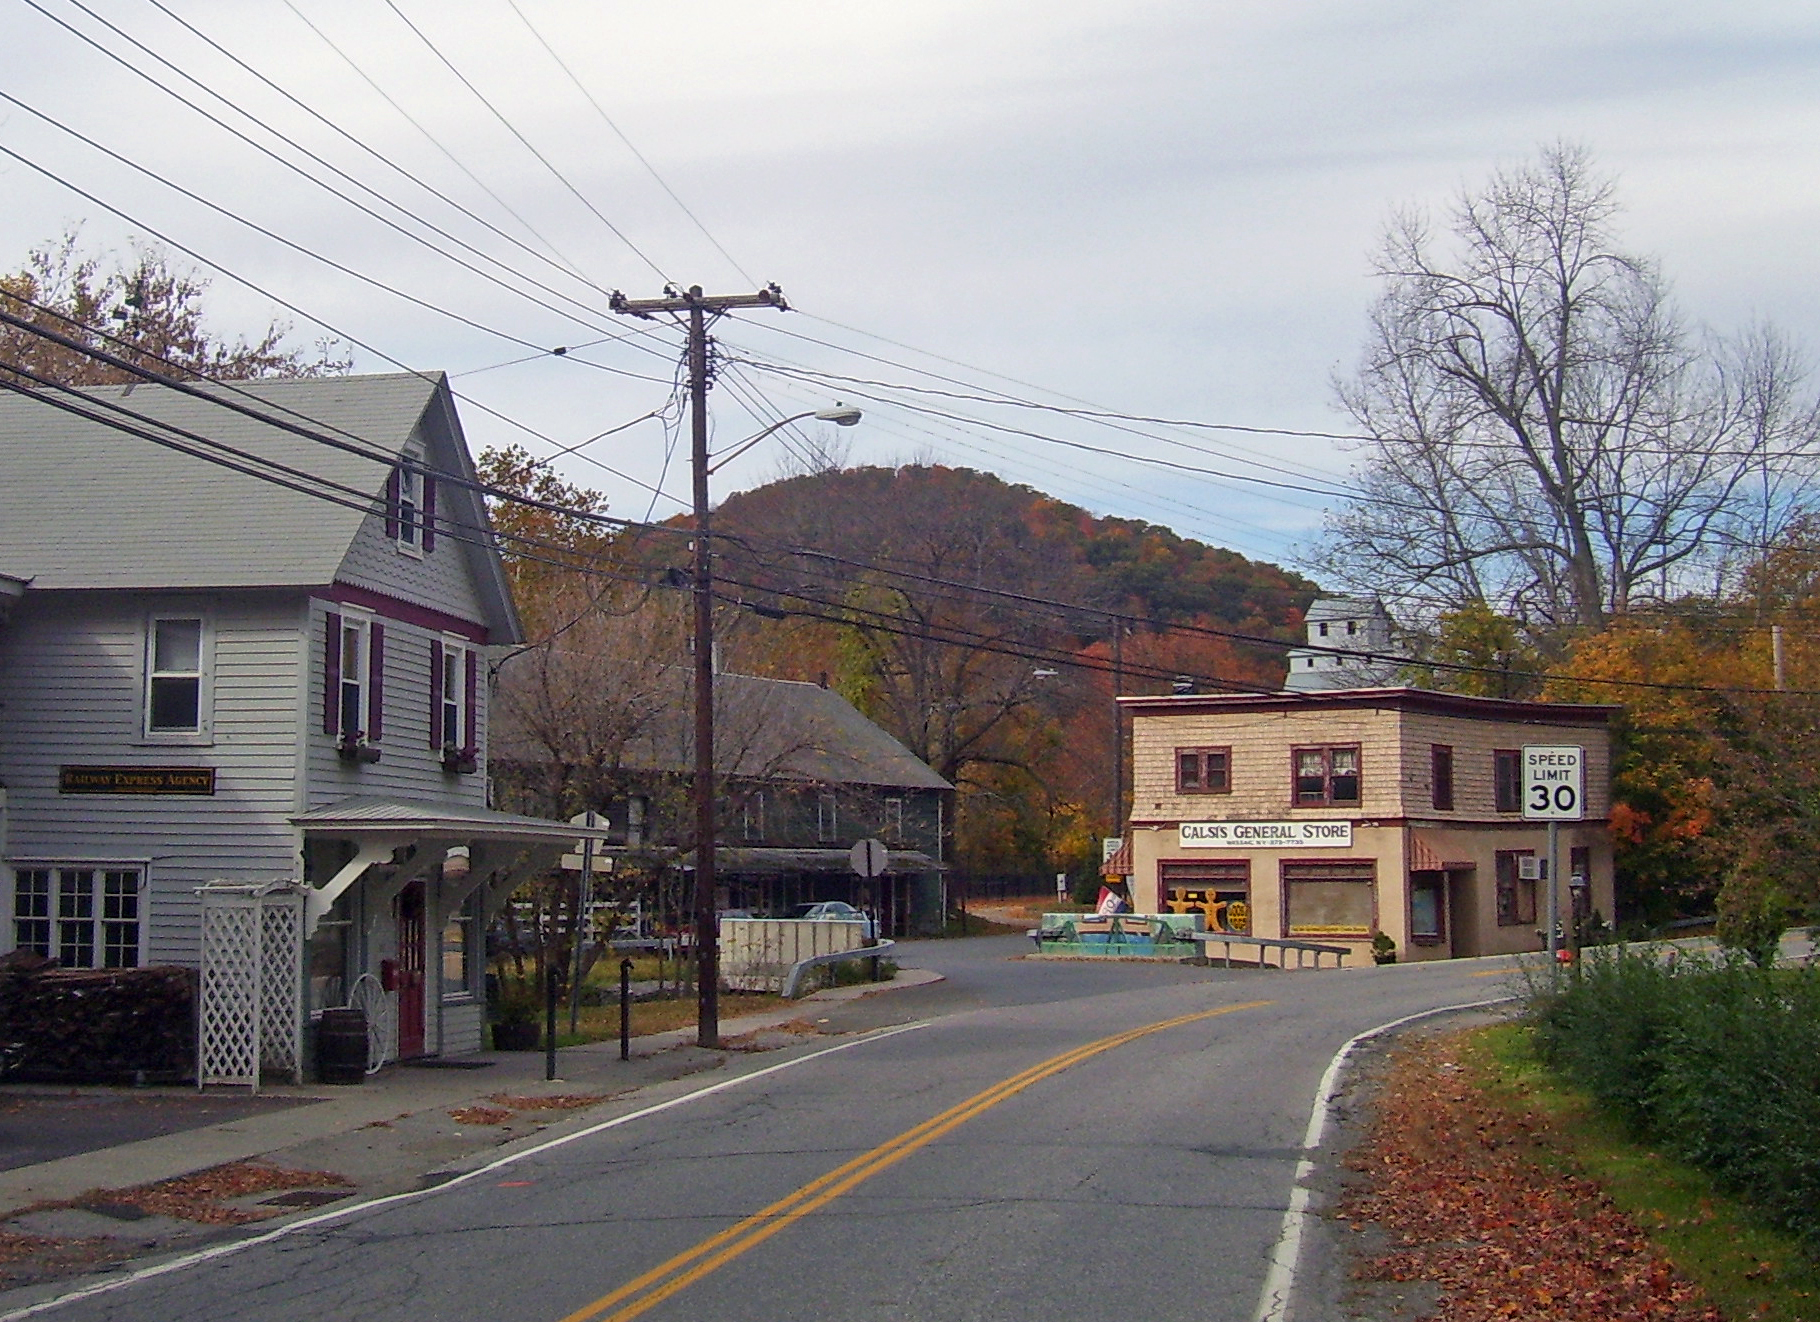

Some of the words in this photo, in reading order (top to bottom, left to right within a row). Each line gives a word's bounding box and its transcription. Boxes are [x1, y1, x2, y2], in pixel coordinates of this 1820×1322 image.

[1528, 754, 1577, 766] SPEED
[65, 773, 111, 785] RAILWAY
[115, 773, 163, 785] EXPRESS
[168, 774, 209, 786] AGENCY
[1533, 769, 1571, 780] LIMIT
[1529, 784, 1576, 811] 30
[1233, 825, 1297, 839] GENERAL
[1302, 824, 1349, 838] STORE
